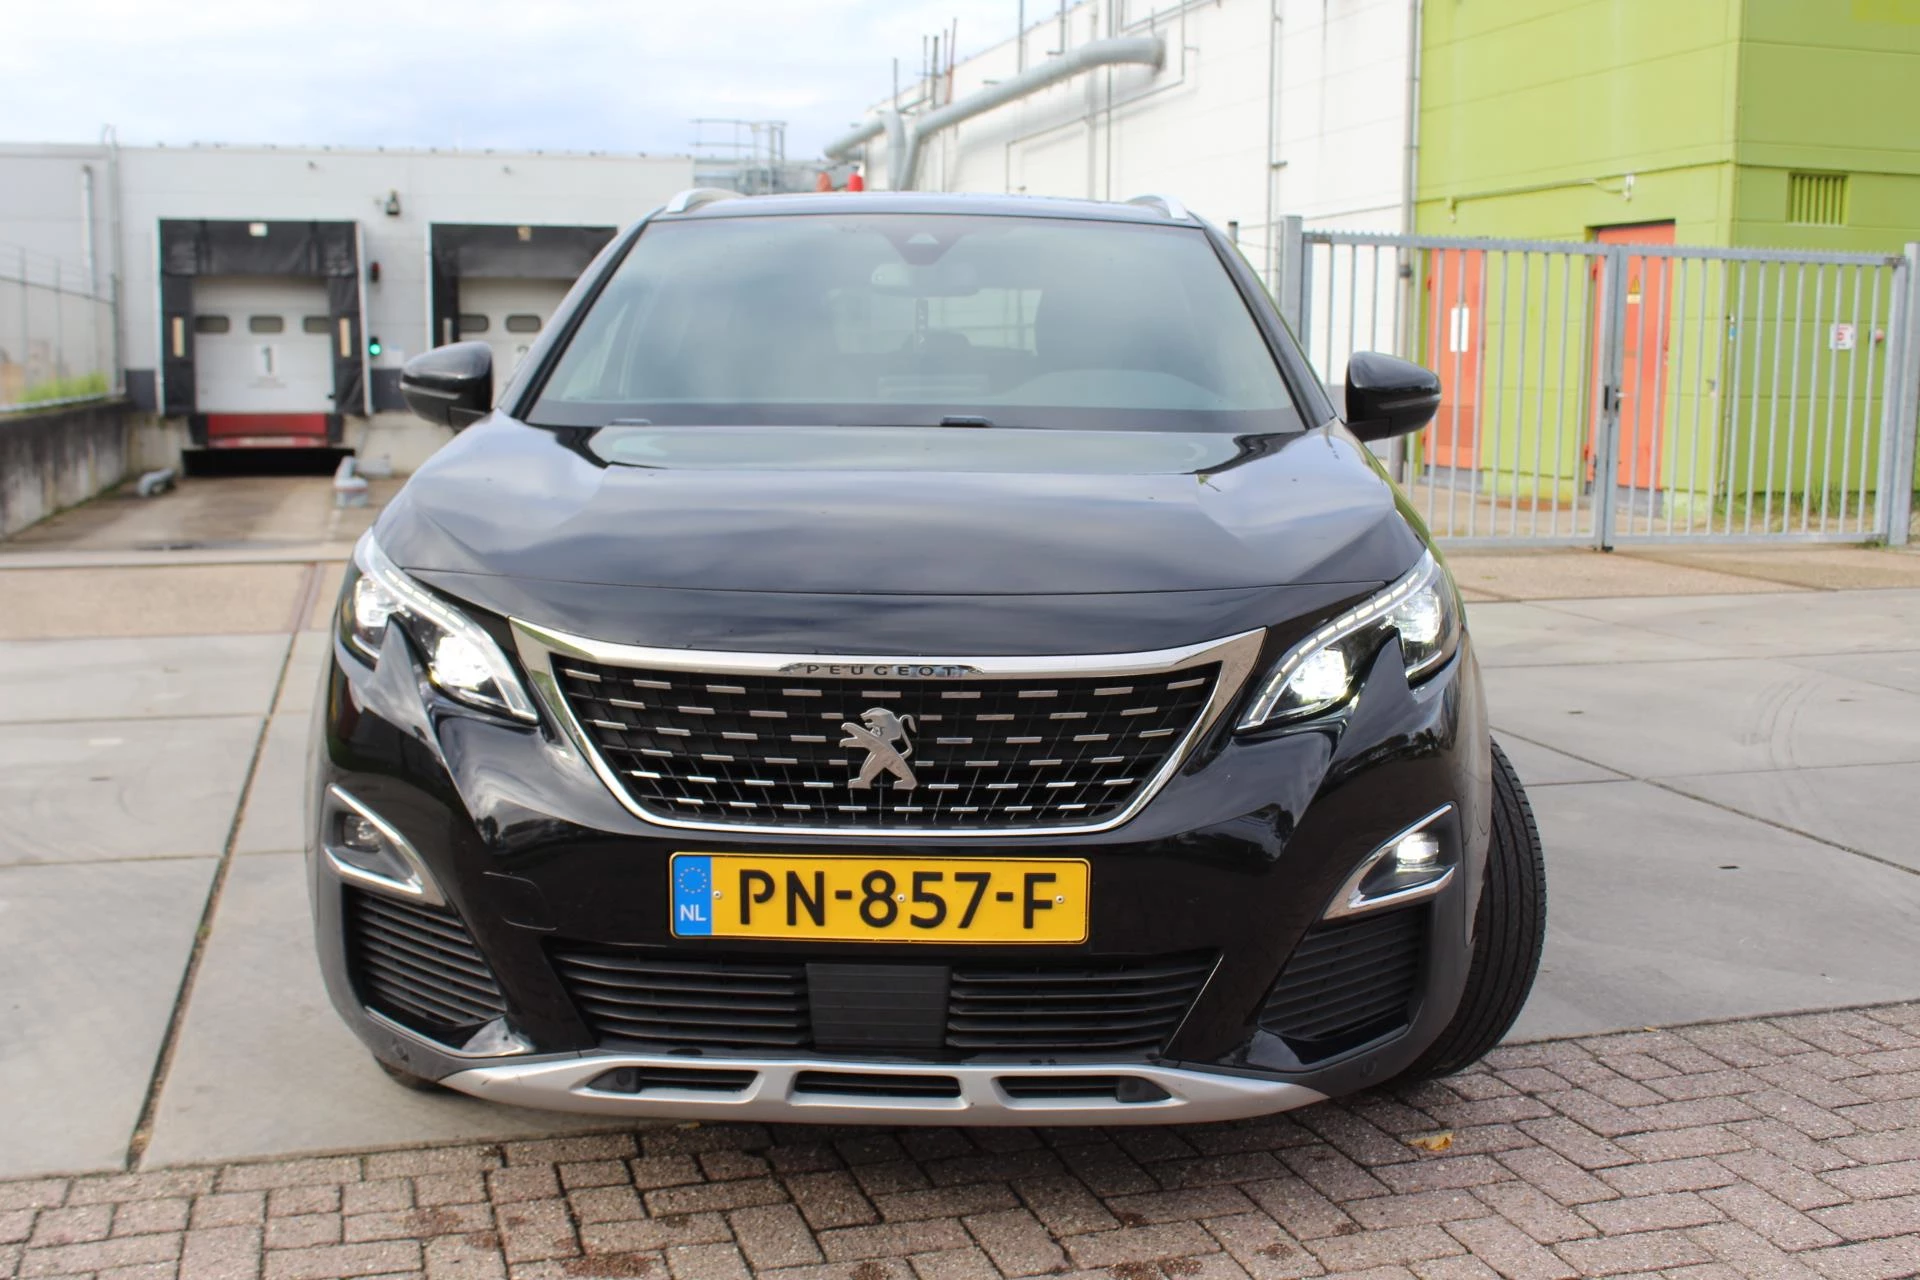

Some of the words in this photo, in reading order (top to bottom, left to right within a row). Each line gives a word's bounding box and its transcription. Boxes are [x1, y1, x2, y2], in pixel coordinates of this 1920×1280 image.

[261, 345, 273, 375] 1
[806, 664, 955, 677] PEUGEOT
[739, 869, 1057, 929] PN-857-F
[679, 904, 707, 922] NL
